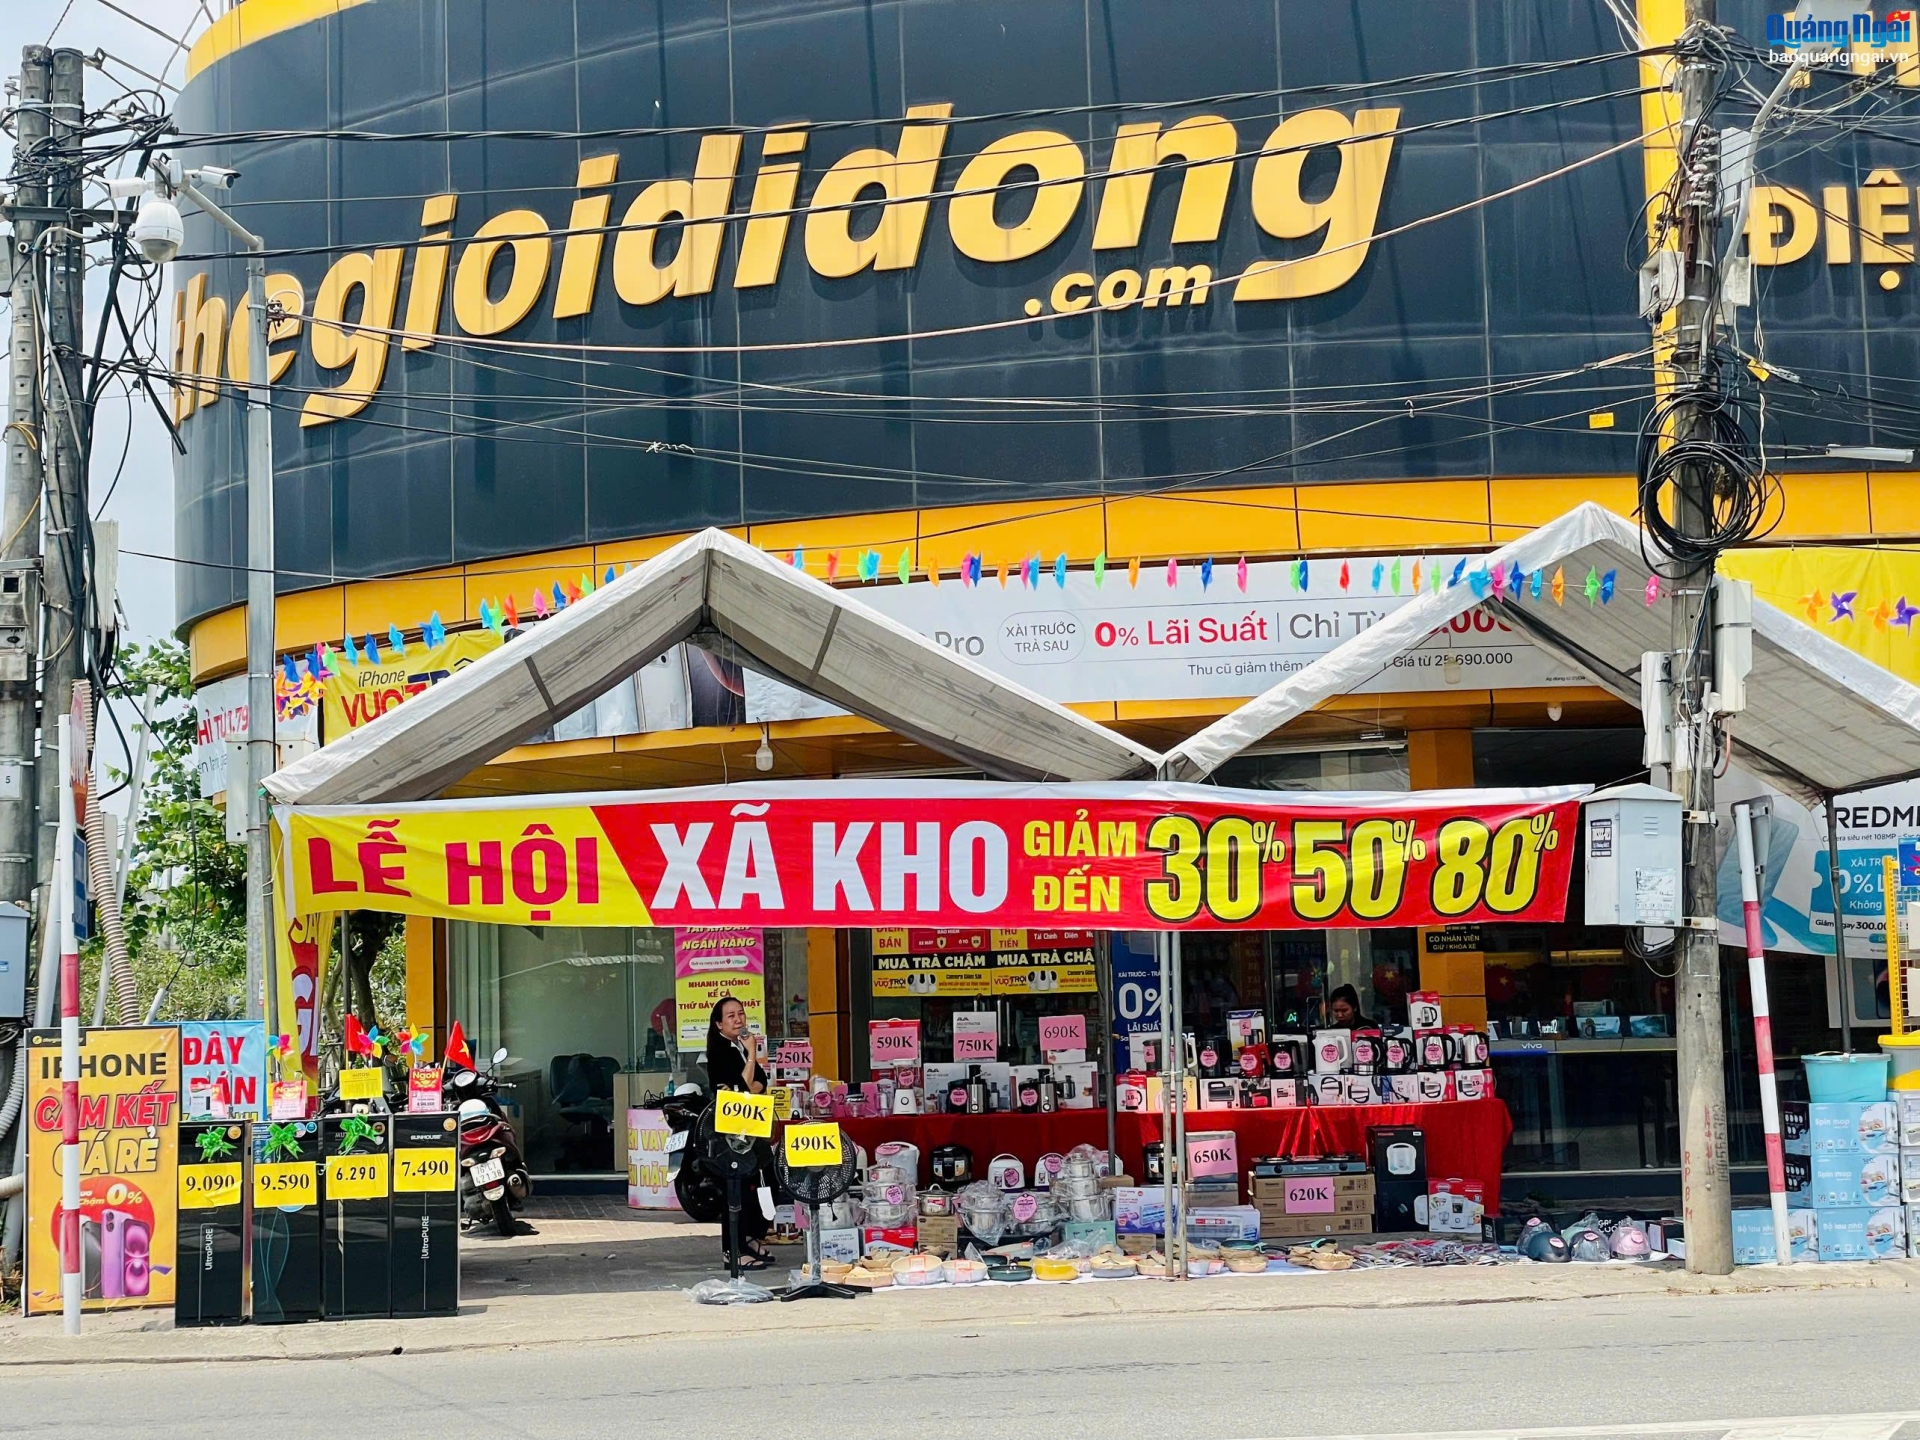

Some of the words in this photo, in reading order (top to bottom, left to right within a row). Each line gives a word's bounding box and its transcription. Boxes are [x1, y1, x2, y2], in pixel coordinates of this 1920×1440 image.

[1743, 168, 1920, 291] ĐIỆ
[1024, 264, 1212, 316] .com
[1006, 624, 1030, 637] XÀI
[1033, 622, 1076, 636] TRƯỚC
[1094, 620, 1139, 648] 0%
[1147, 618, 1190, 645] Lãi
[1198, 609, 1268, 643] Suất
[1289, 612, 1340, 638] Chỉ
[1043, 640, 1069, 652] SAU
[1188, 664, 1213, 676] Thu
[1216, 662, 1232, 675] cũ
[1269, 659, 1304, 673] thêm
[1393, 655, 1415, 668] Giá
[1418, 653, 1432, 667] từ
[358, 670, 405, 687] iPhone
[1023, 808, 1137, 858] GIẢM
[650, 802, 783, 910] XÃ
[811, 820, 1009, 914] KHO
[307, 820, 411, 896] LỄ
[446, 823, 598, 921] HỘI
[1144, 815, 1286, 922] 30%
[1290, 816, 1426, 923] 50%
[1431, 811, 1558, 917] 80%
[1032, 867, 1120, 912] ĐẾN
[1849, 900, 1882, 910] Không
[682, 938, 718, 950] NGÂN
[720, 936, 756, 949] HÀNG
[878, 958, 910, 969] MUA
[944, 952, 986, 969] CHẬM
[997, 954, 1029, 966] MUA
[1063, 948, 1094, 965] CHẬ
[688, 980, 718, 988] NHANH
[1044, 1025, 1080, 1039] 690K
[183, 1031, 245, 1065] ĐÂY
[877, 1036, 914, 1049] 590K
[958, 1039, 994, 1052] 750K
[776, 1052, 812, 1064] 250K
[114, 1081, 176, 1127] KẾT
[722, 1101, 768, 1122] 690K
[115, 1126, 160, 1173] RẺ
[790, 1134, 836, 1151] 490K
[1193, 1148, 1232, 1164] 650K
[336, 1166, 376, 1181] 6.290
[401, 1160, 449, 1177] 7.490
[185, 1174, 236, 1192] 9.090
[260, 1173, 310, 1191] 9.590
[107, 1183, 143, 1206] 0%
[1289, 1187, 1329, 1201] 620K
